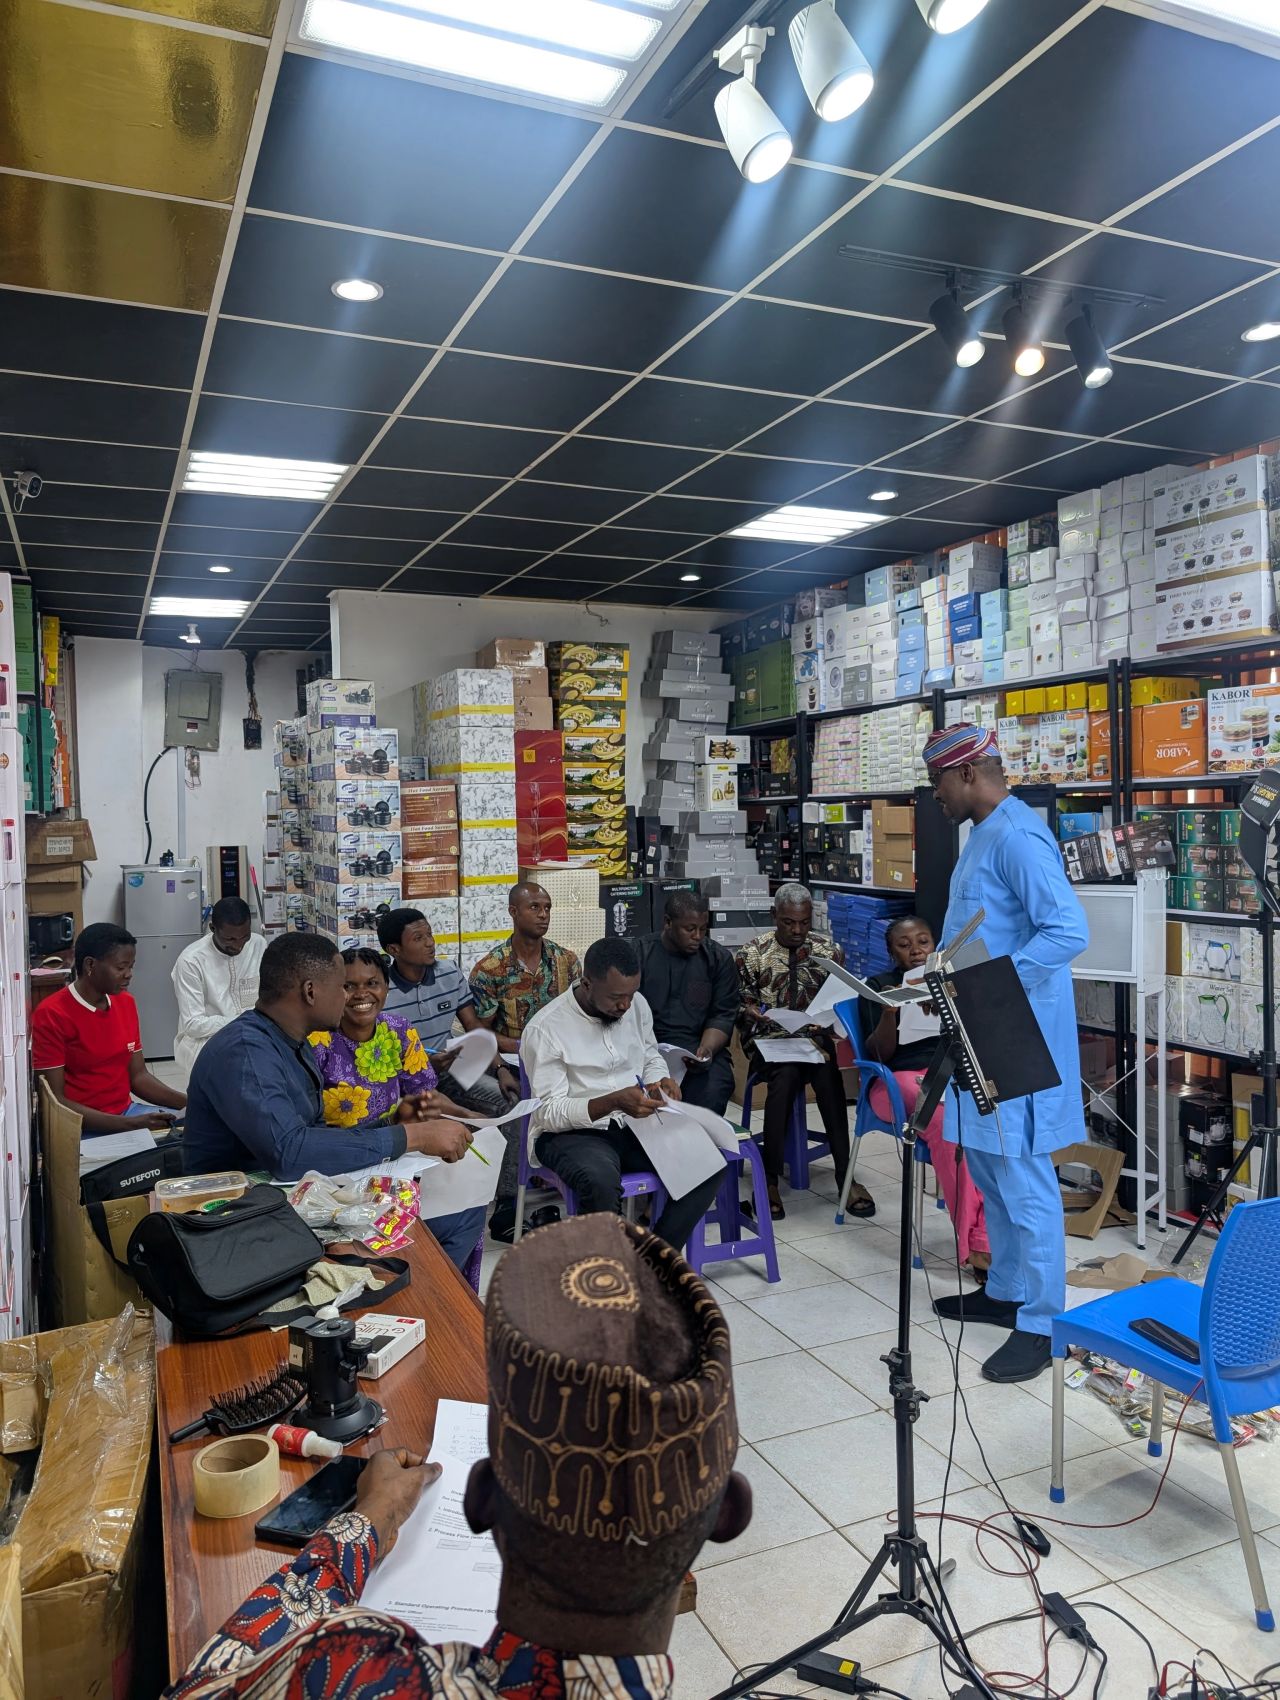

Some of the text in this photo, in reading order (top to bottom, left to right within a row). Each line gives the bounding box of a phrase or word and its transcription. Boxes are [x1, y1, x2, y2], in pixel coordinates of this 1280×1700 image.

[1211, 689, 1250, 701] KABOR
[1041, 713, 1065, 723] KABOR
[1156, 747, 1191, 758] KABOR
[1209, 984, 1226, 993] Water
[120, 1168, 161, 1187] SUTEFOTO
